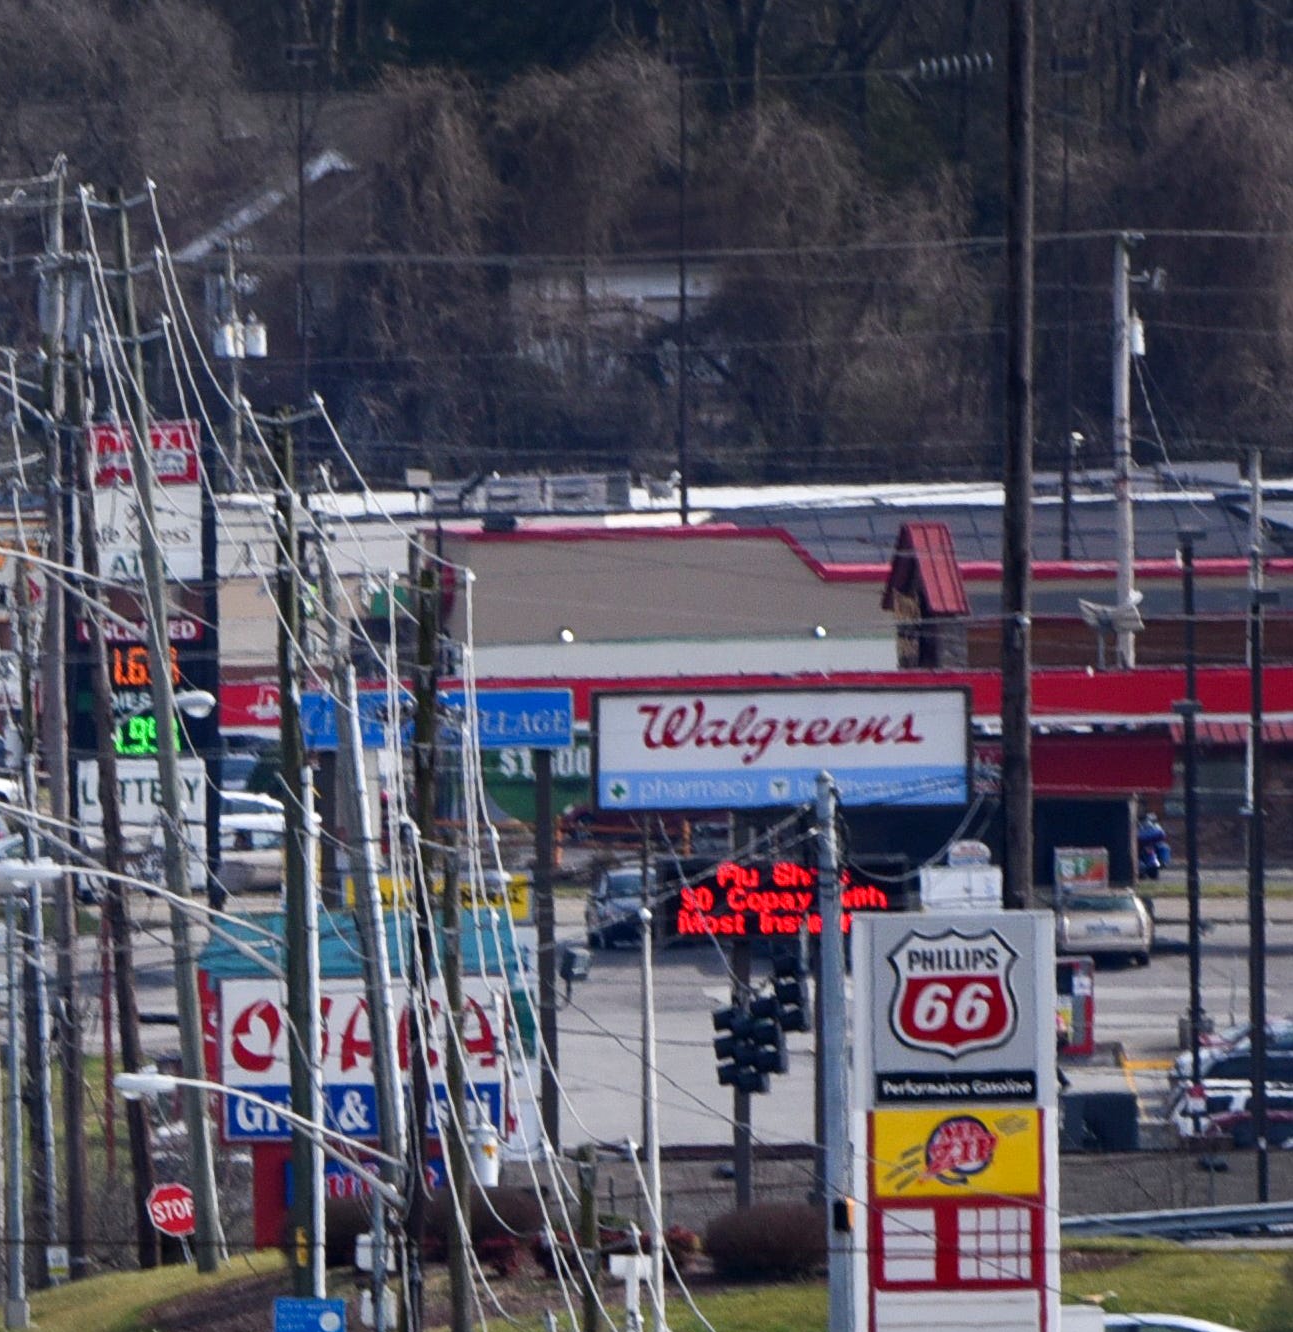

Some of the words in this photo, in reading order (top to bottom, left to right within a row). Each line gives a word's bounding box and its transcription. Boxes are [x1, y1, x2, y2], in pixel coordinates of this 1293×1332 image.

[637, 699, 924, 764] Walgreens
[638, 778, 759, 800] pharmacy
[717, 862, 759, 888] Flu
[727, 886, 812, 912] Copay
[677, 909, 745, 934] Most
[908, 948, 999, 971] PHILLIPS
[913, 982, 994, 1032] 66
[972, 1078, 1033, 1095] Gasoline
[339, 1089, 371, 1132] &
[152, 1200, 194, 1223] STOP
